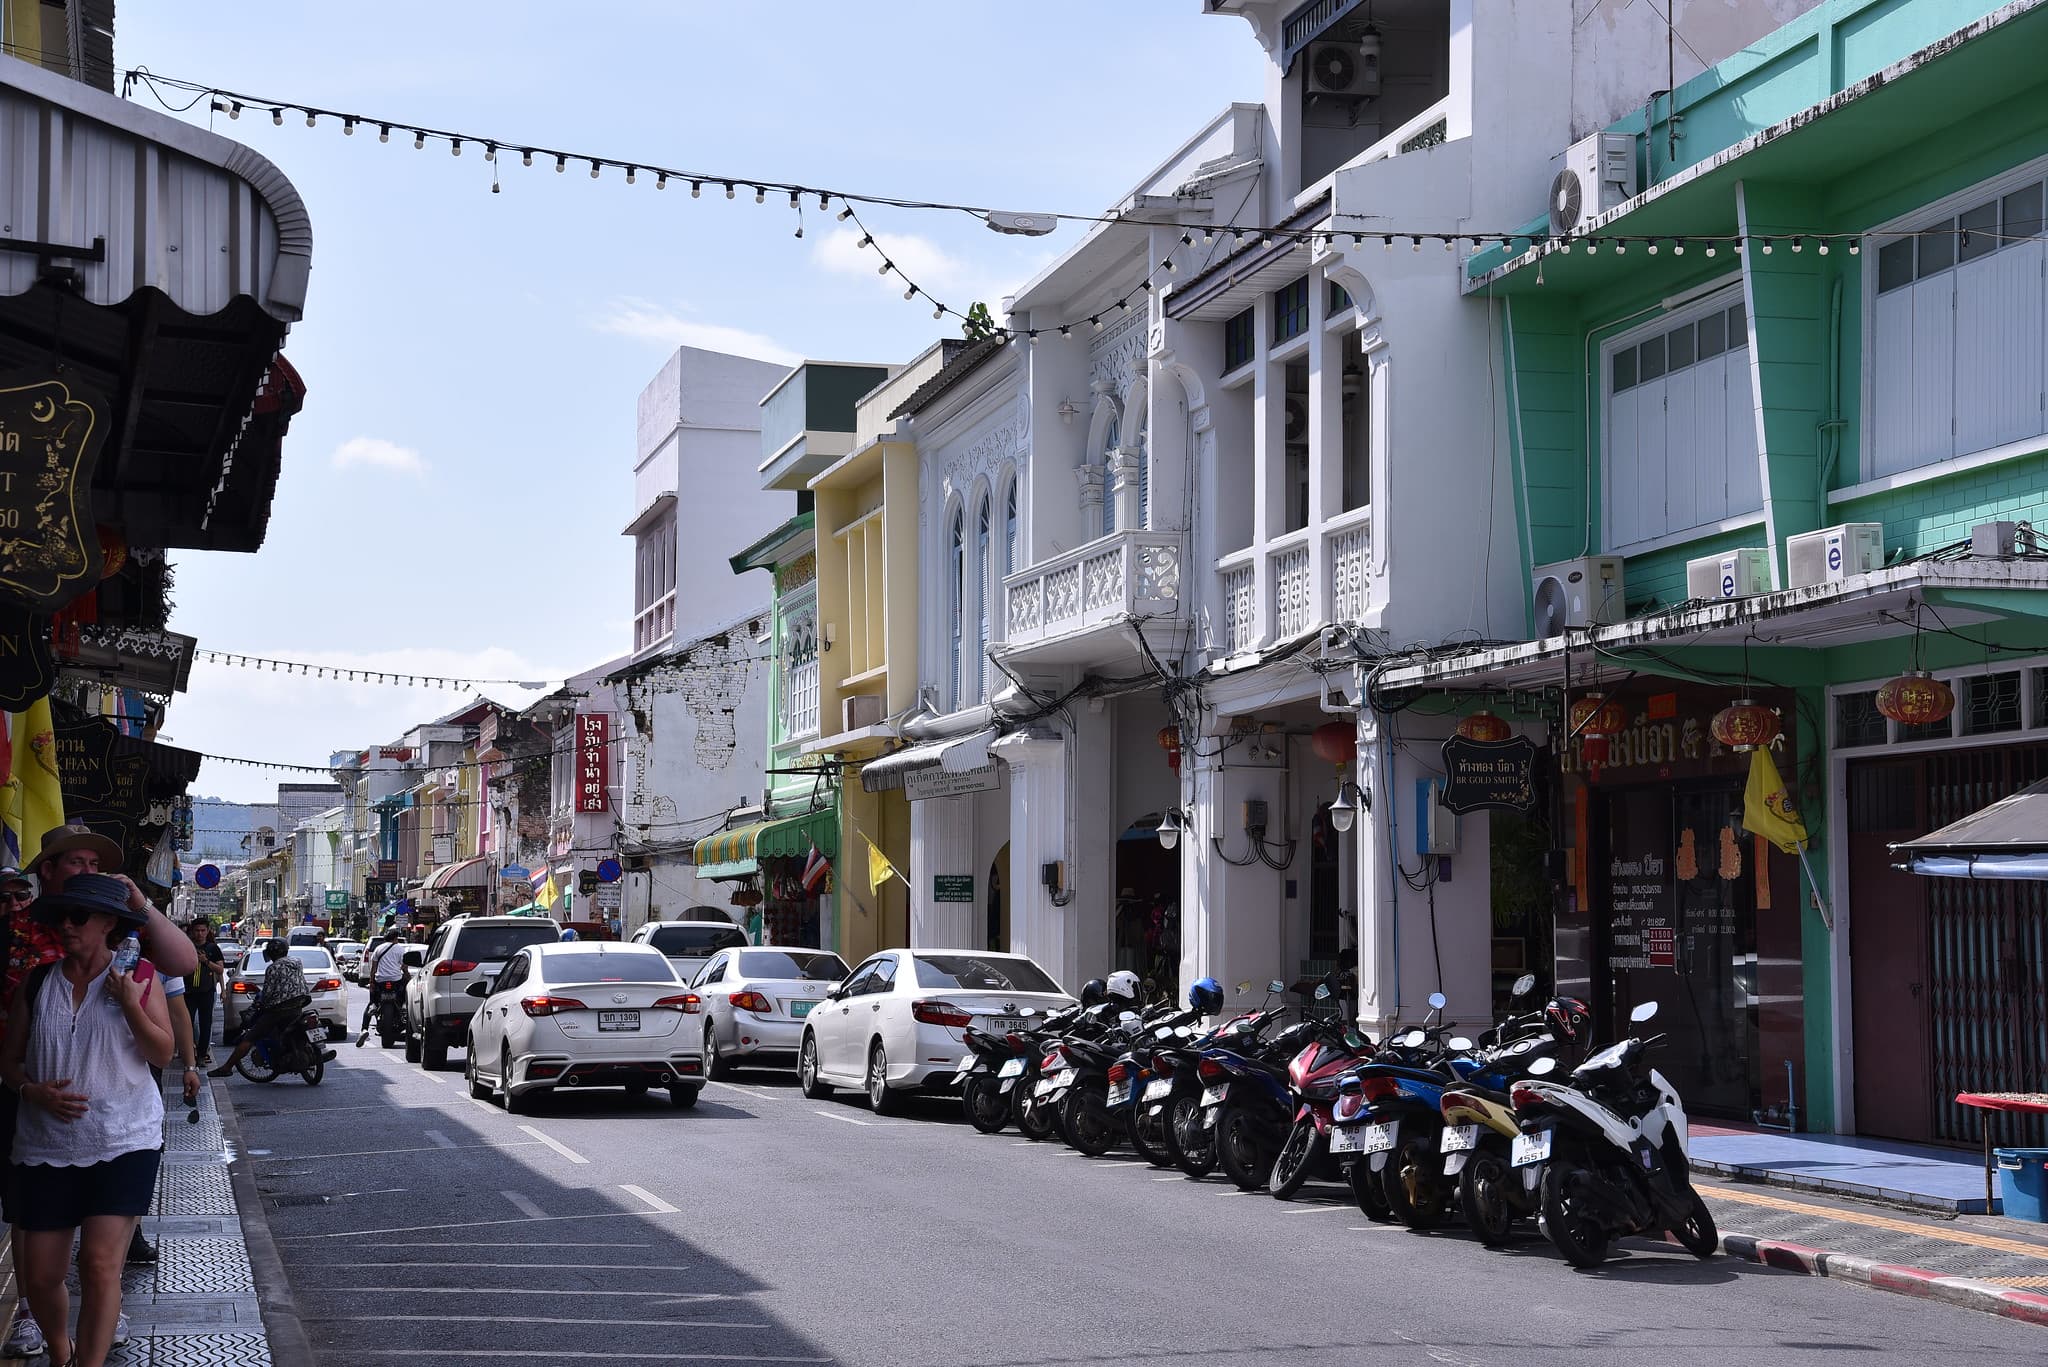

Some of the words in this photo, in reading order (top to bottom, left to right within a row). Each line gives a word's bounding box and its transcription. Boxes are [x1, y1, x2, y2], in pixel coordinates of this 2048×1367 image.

[1459, 757, 1493, 773] ห้างทอง
[1456, 776, 1468, 785] BR
[1469, 776, 1492, 785] GOLD
[1493, 776, 1519, 785] SMITH
[620, 1013, 638, 1022] 1309
[1008, 1020, 1028, 1030] 3645
[1339, 1141, 1361, 1151] 581
[1367, 1140, 1391, 1153] 3536
[1447, 1141, 1468, 1151] 573
[1517, 1150, 1545, 1165] 4551
